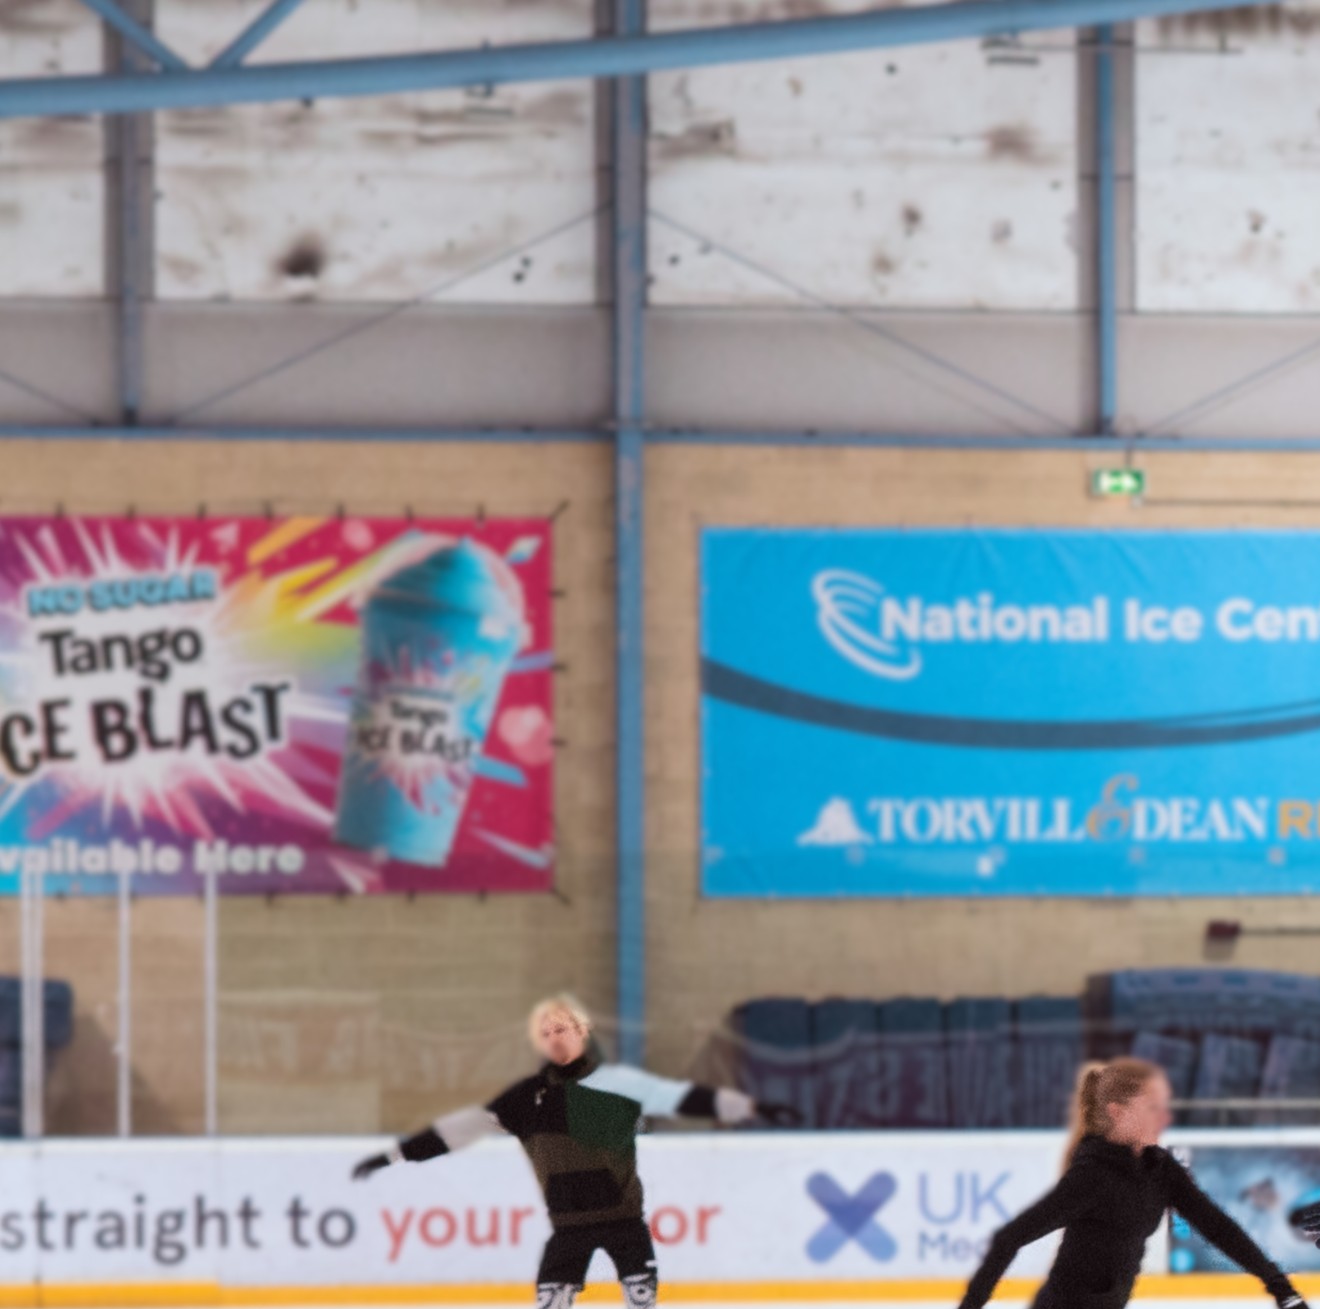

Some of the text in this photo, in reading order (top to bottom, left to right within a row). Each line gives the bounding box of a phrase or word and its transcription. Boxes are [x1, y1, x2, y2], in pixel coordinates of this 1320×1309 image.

[879, 595, 1108, 642] National
[1125, 598, 1202, 642] Ice
[39, 625, 205, 684] Tango
[90, 682, 290, 763] BLAST
[868, 797, 1085, 842] TORVILL
[1131, 797, 1268, 842] DEAN
[193, 837, 305, 874] Here
[917, 1170, 1012, 1226] UK
[0, 1192, 723, 1267] straight to your or
